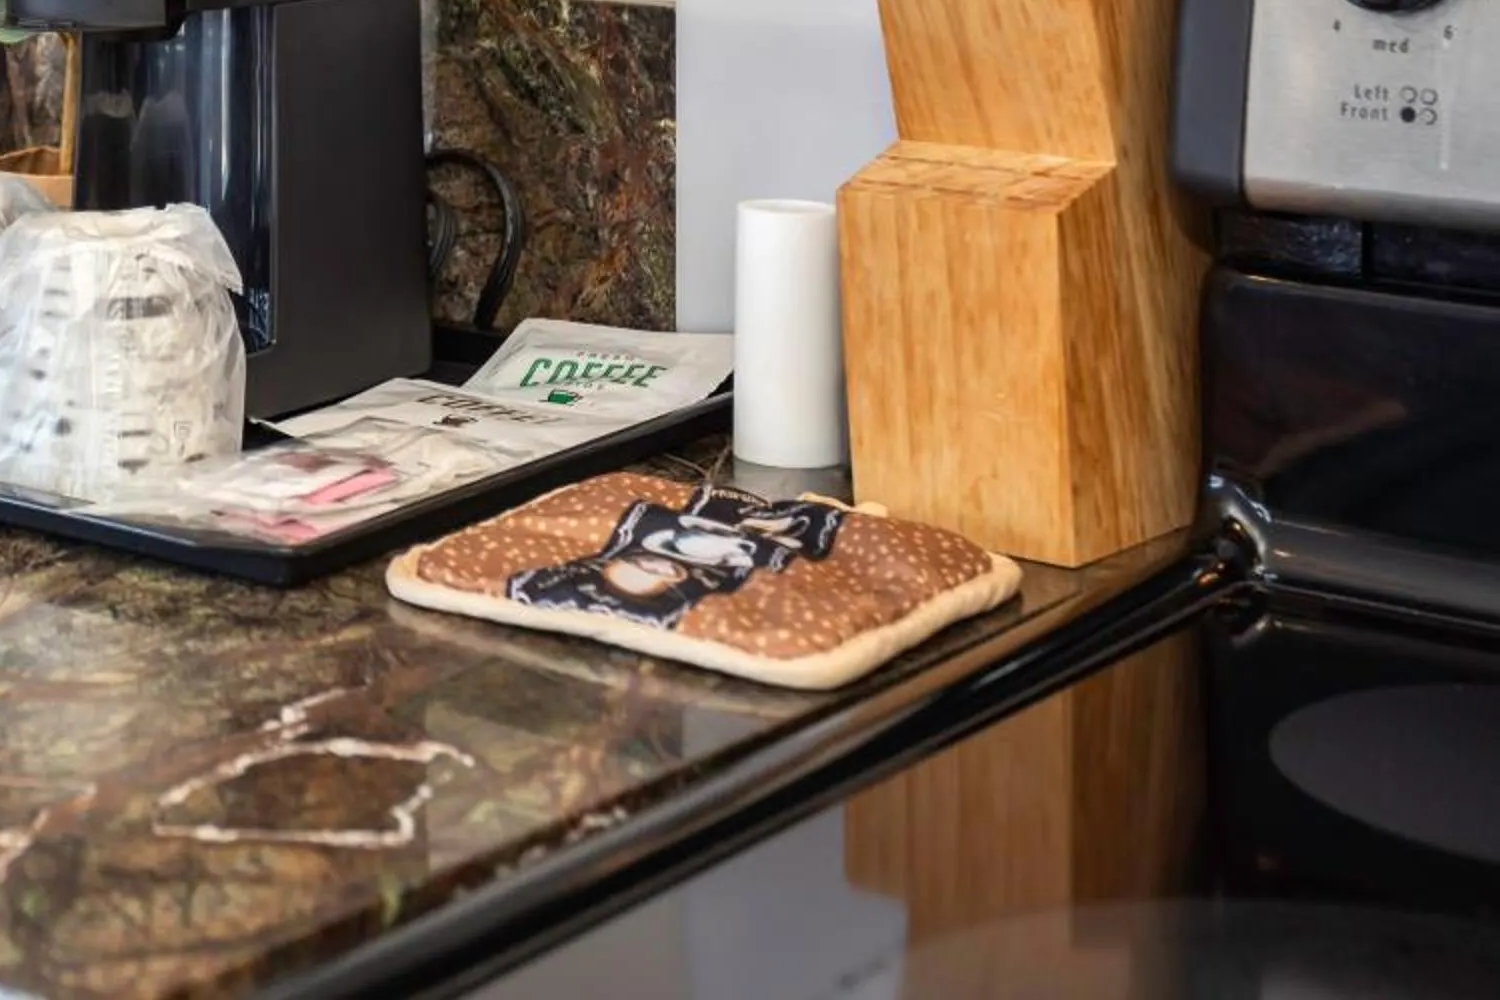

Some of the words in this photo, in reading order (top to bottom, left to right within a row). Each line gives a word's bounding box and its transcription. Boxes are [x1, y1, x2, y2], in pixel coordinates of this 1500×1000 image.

[1372, 37, 1411, 53] med
[1354, 84, 1389, 102] Left
[1340, 101, 1389, 122] Front
[518, 357, 669, 388] COFFEE
